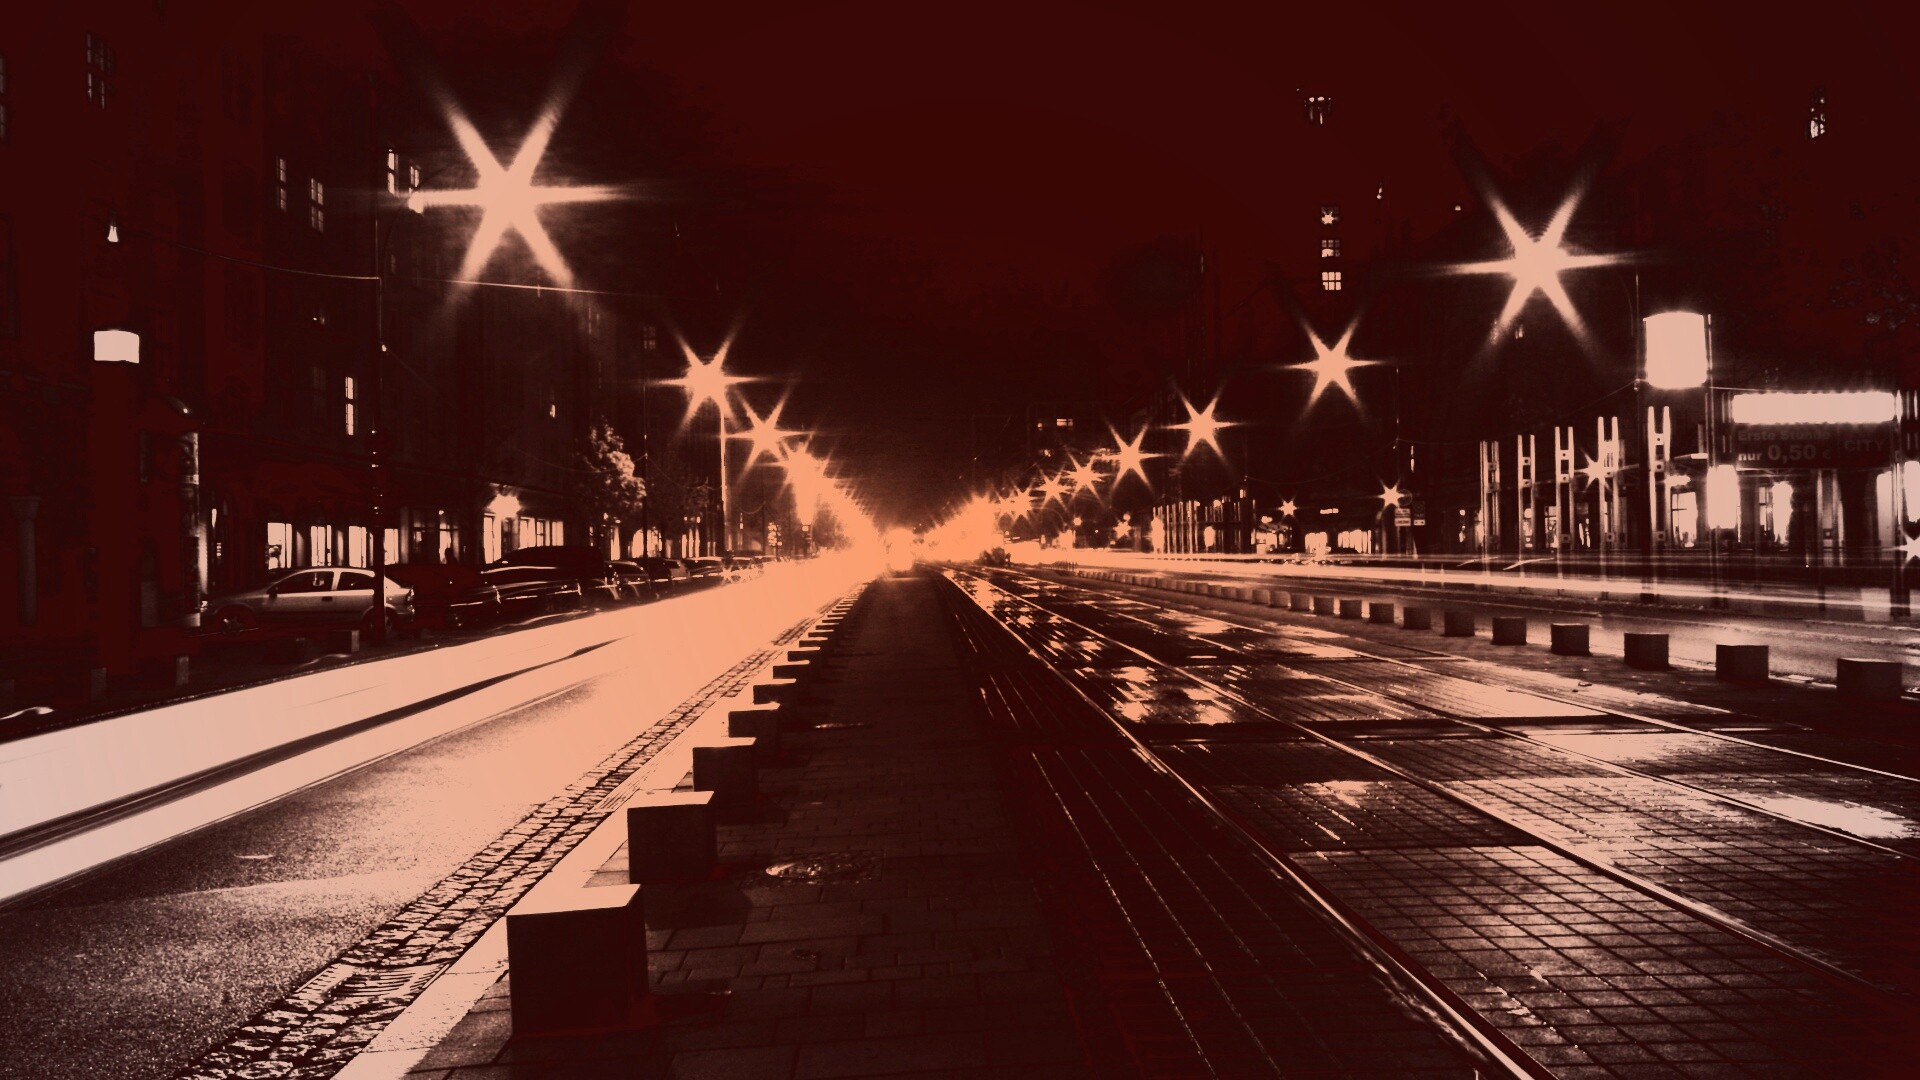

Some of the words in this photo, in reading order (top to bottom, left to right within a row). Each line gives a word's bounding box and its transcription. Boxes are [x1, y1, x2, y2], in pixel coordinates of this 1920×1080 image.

[1738, 430, 1776, 441] Erste
[1844, 439, 1885, 452] CITY
[1738, 453, 1763, 461] nur
[1768, 444, 1816, 464] 0,50
